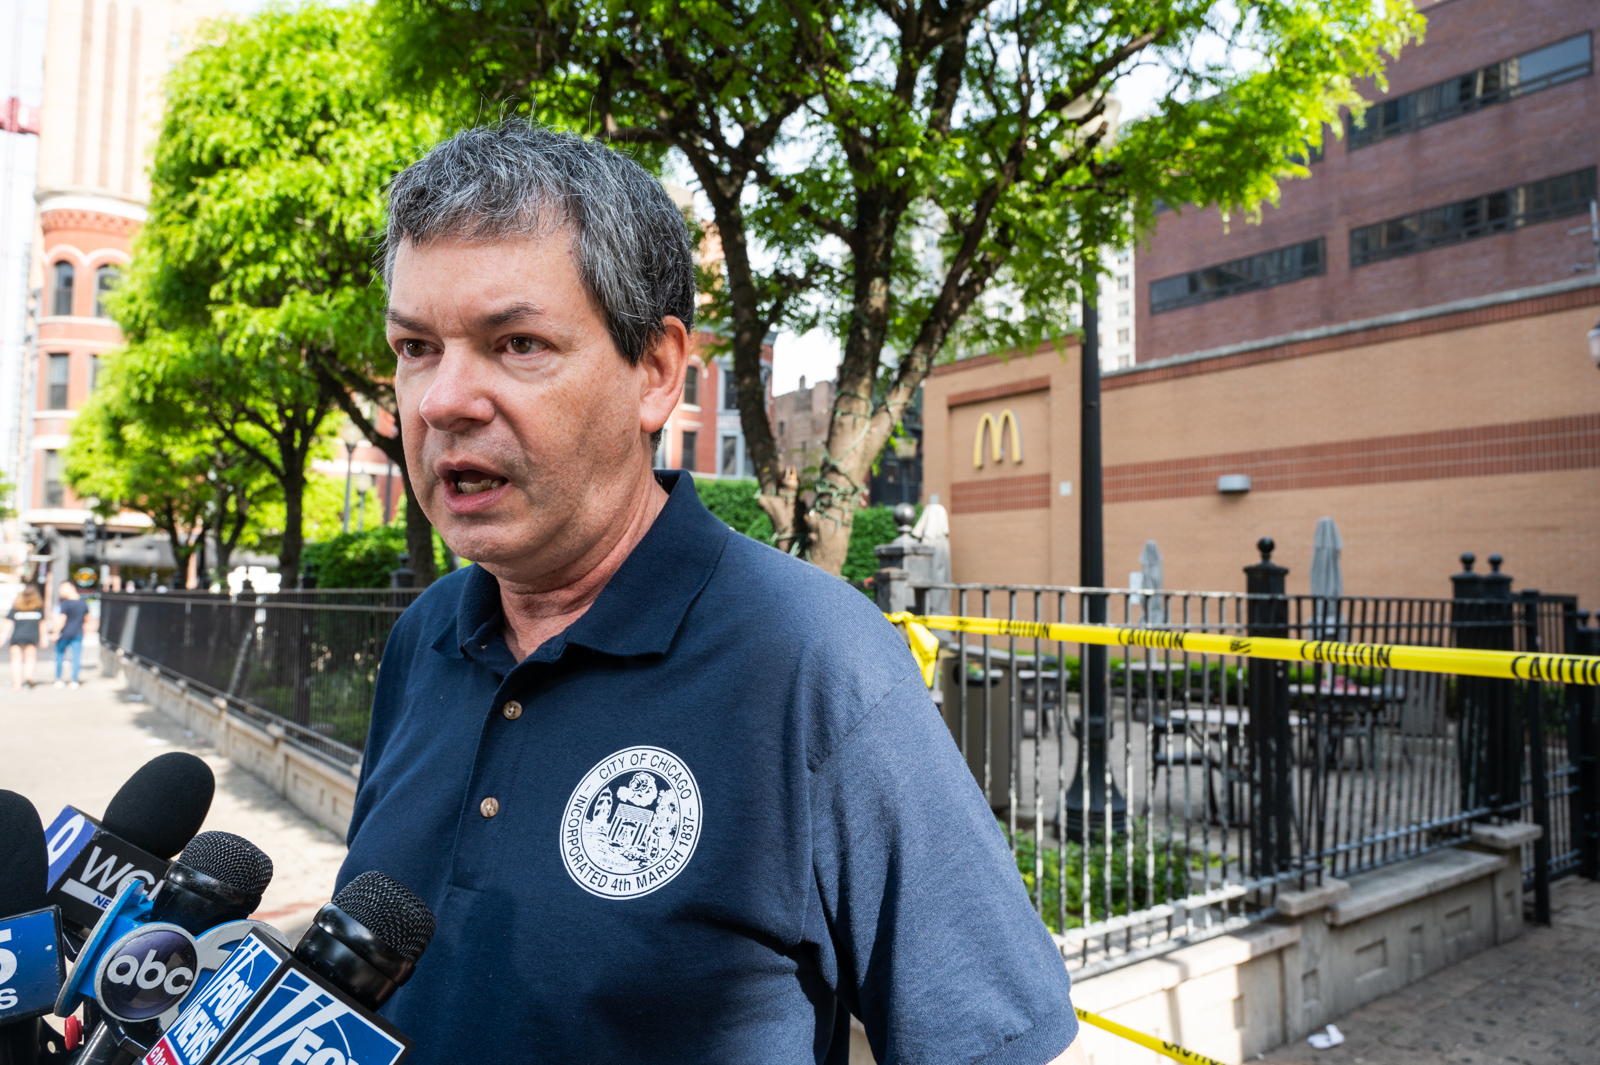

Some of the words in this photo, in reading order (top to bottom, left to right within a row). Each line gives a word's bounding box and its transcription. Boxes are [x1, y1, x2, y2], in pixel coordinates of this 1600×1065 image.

[1117, 629, 1184, 649] CAUTION
[1301, 641, 1391, 667] CAUTION
[599, 756, 625, 780] CITY
[630, 753, 648, 766] OF
[650, 754, 692, 800] CHICAGO
[566, 794, 608, 888] INCORPORATED
[611, 878, 631, 891] 4th
[636, 849, 684, 889] MARCH
[679, 816, 695, 847] 1837
[79, 845, 165, 901] WG
[106, 949, 194, 996] abc
[207, 970, 254, 1028] FOX
[150, 1046, 170, 1065] cha
[173, 1003, 220, 1065] NEWS
[277, 1027, 360, 1065] FO
